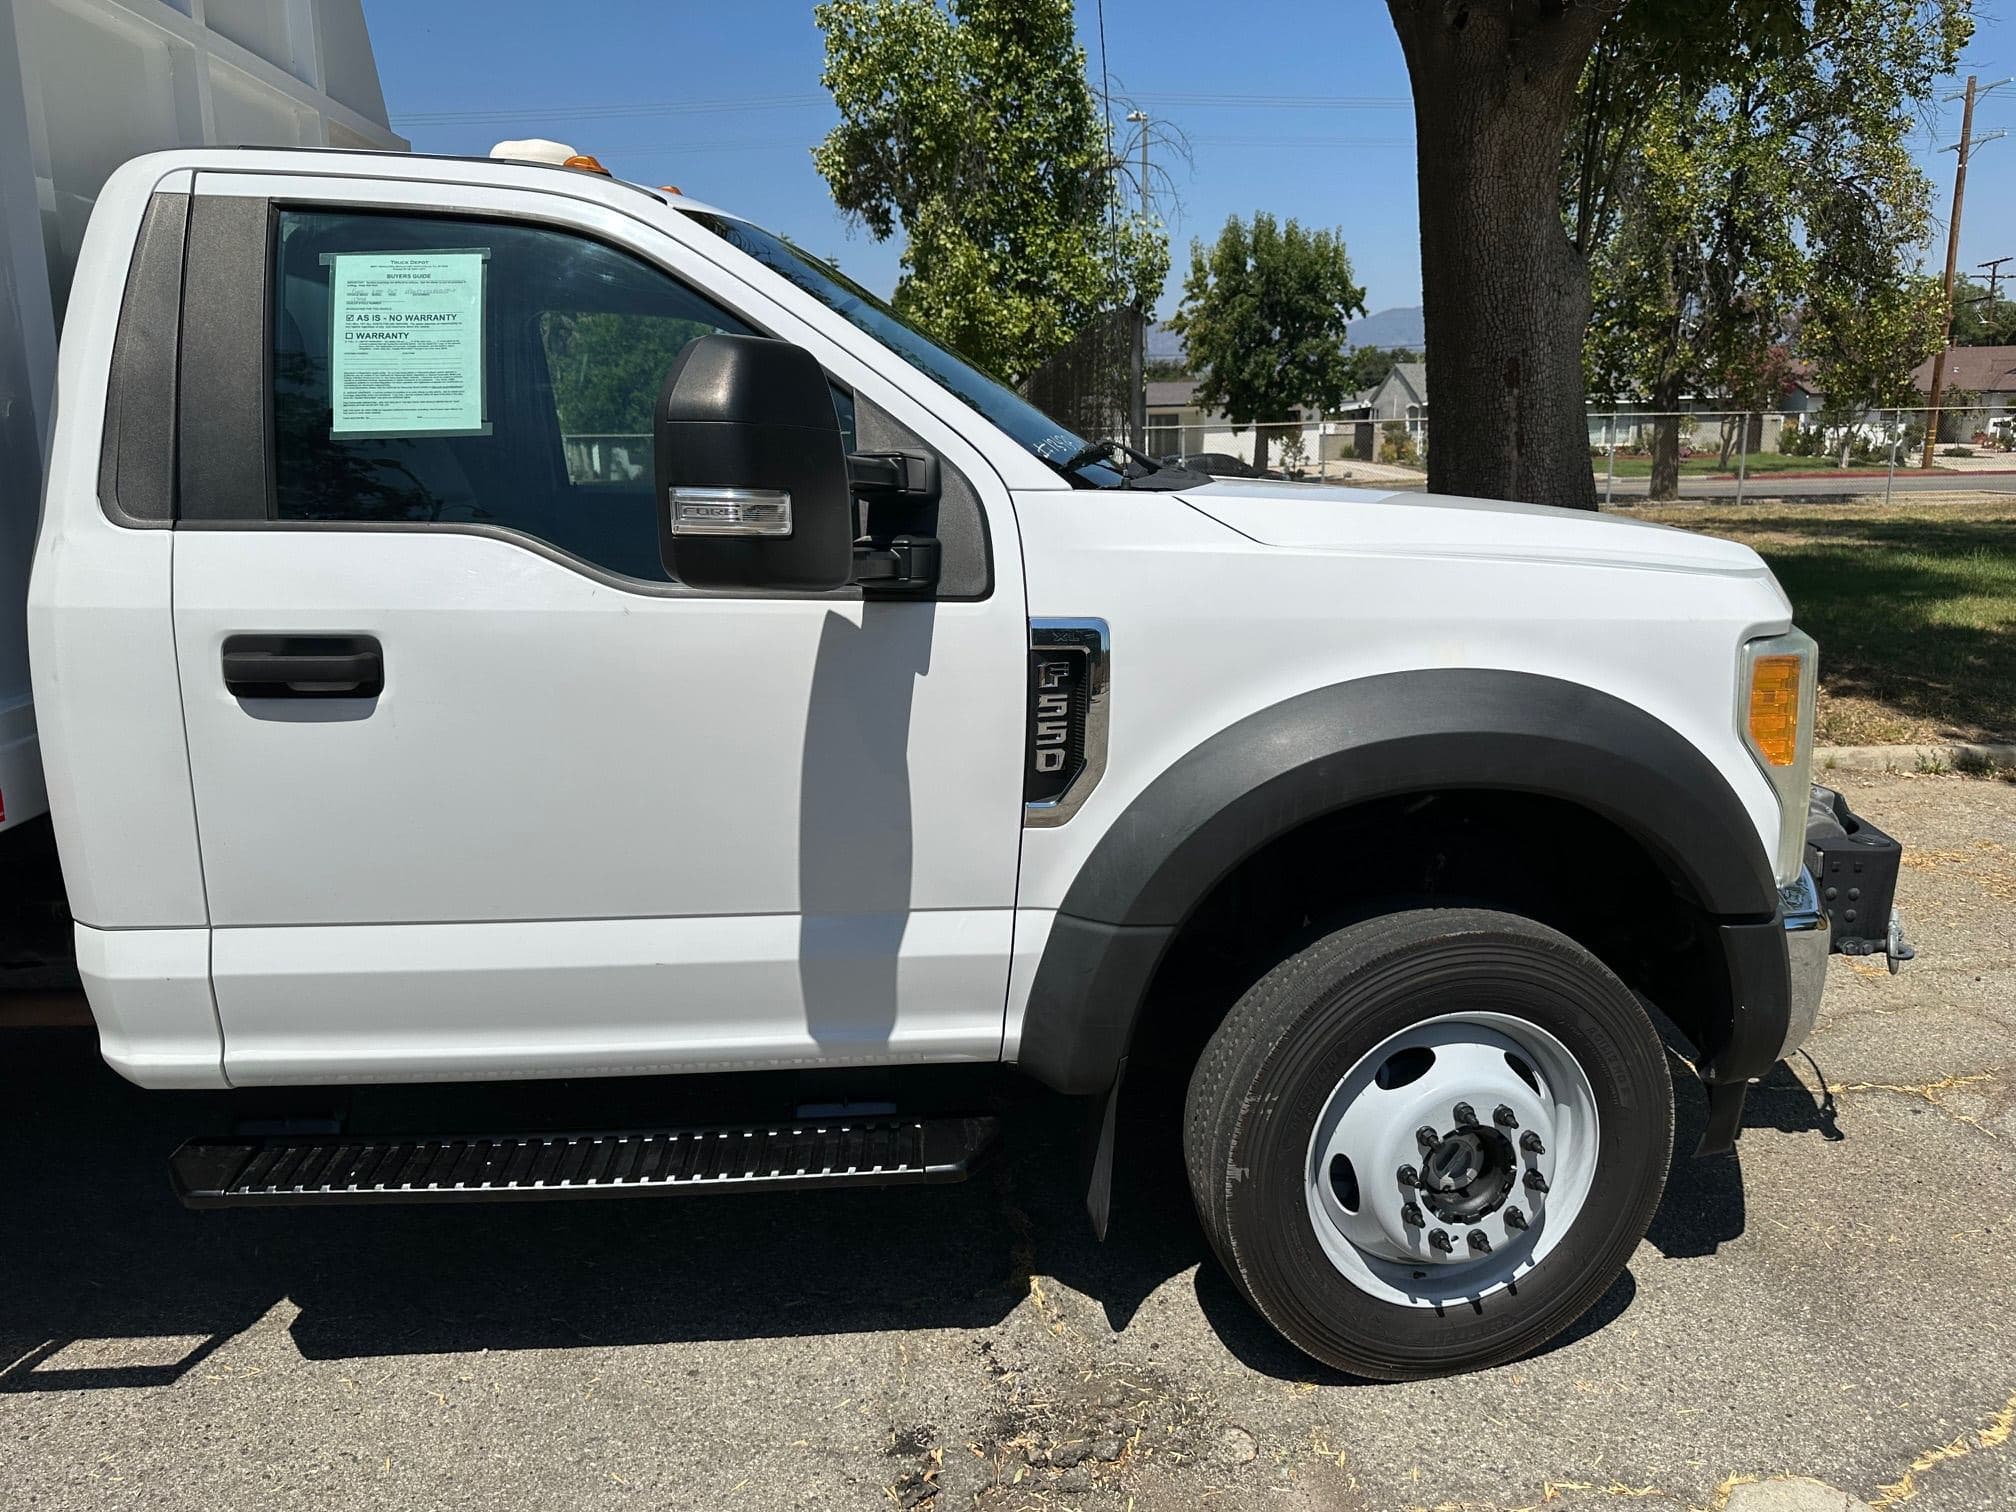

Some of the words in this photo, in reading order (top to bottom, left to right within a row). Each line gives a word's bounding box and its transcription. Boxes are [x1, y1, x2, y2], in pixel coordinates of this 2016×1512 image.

[356, 314, 370, 322] AS
[372, 314, 381, 322] IS
[389, 314, 403, 322] NO
[404, 313, 458, 322] WARRANTY
[355, 332, 410, 340] WARRANTY
[682, 506, 739, 516] FORD
[1052, 631, 1081, 643] XL
[1035, 661, 1070, 773] F550
